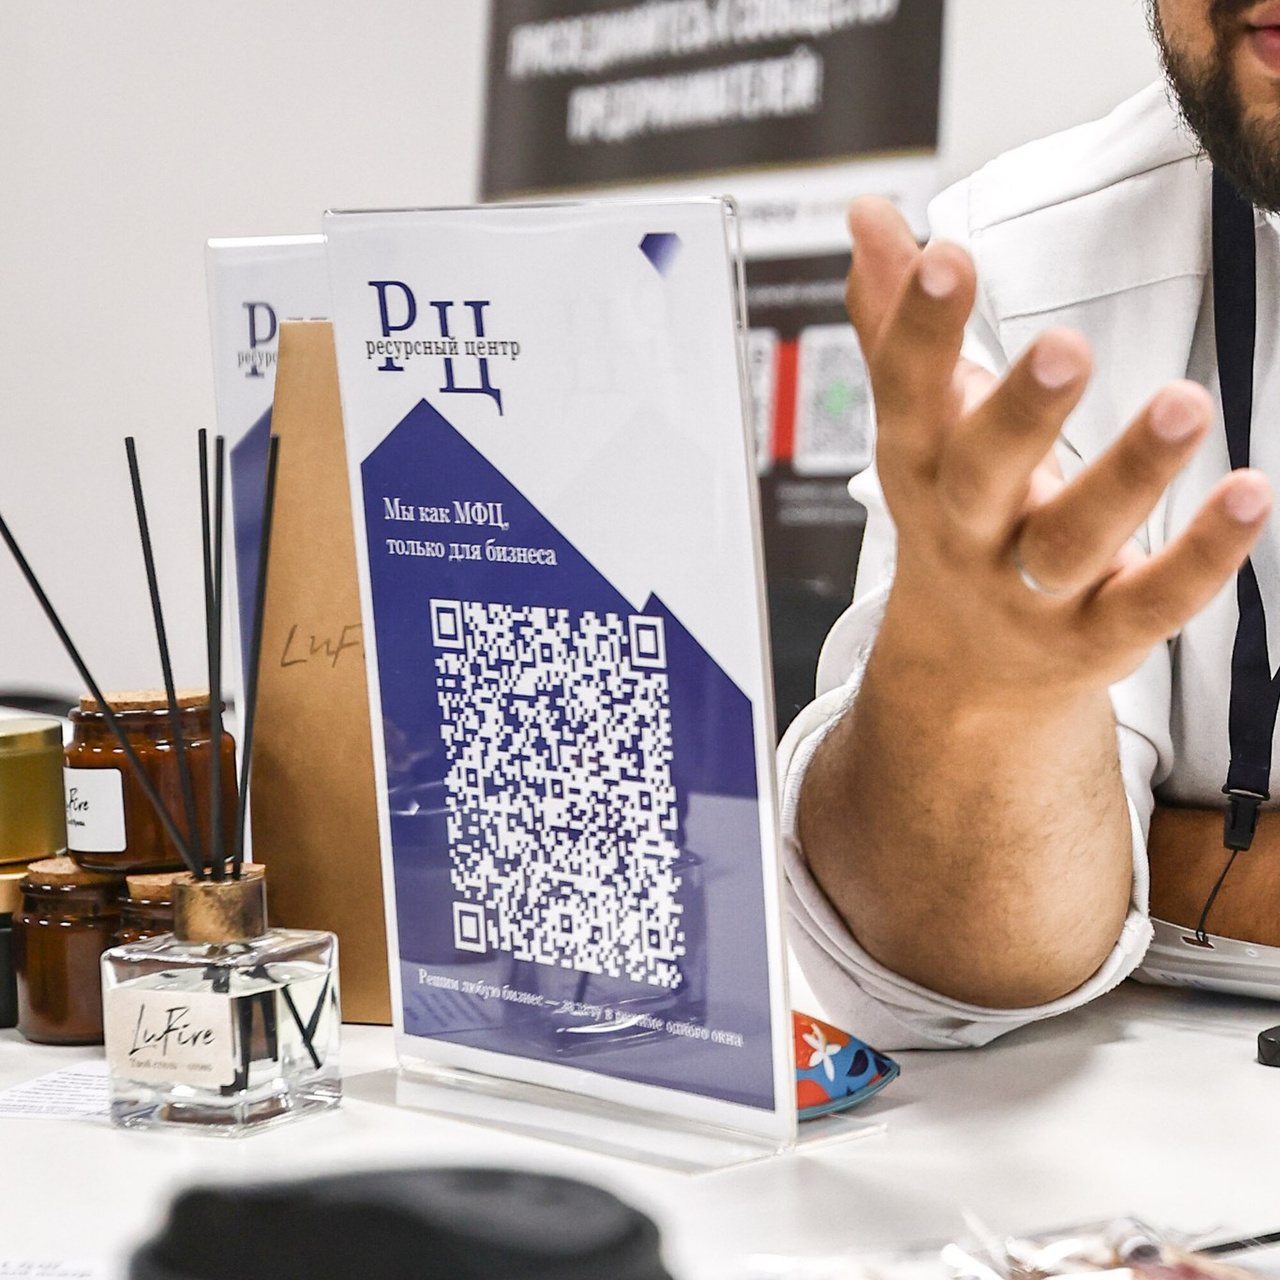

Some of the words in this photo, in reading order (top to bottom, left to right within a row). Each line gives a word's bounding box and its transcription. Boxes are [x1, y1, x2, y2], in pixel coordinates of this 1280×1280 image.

[366, 336, 459, 360] ресурсный
[463, 339, 521, 360] центр
[369, 281, 504, 416] РЦ
[382, 497, 415, 520] Мы
[418, 506, 450, 523] как
[452, 500, 510, 531] МФЦ,
[386, 538, 445, 558] только
[448, 542, 483, 562] для
[485, 538, 558, 566] бизнеса
[281, 623, 365, 668] LuF
[501, 985, 544, 1007] бизнес
[666, 1021, 708, 1041] одного
[711, 1030, 744, 1048] окна
